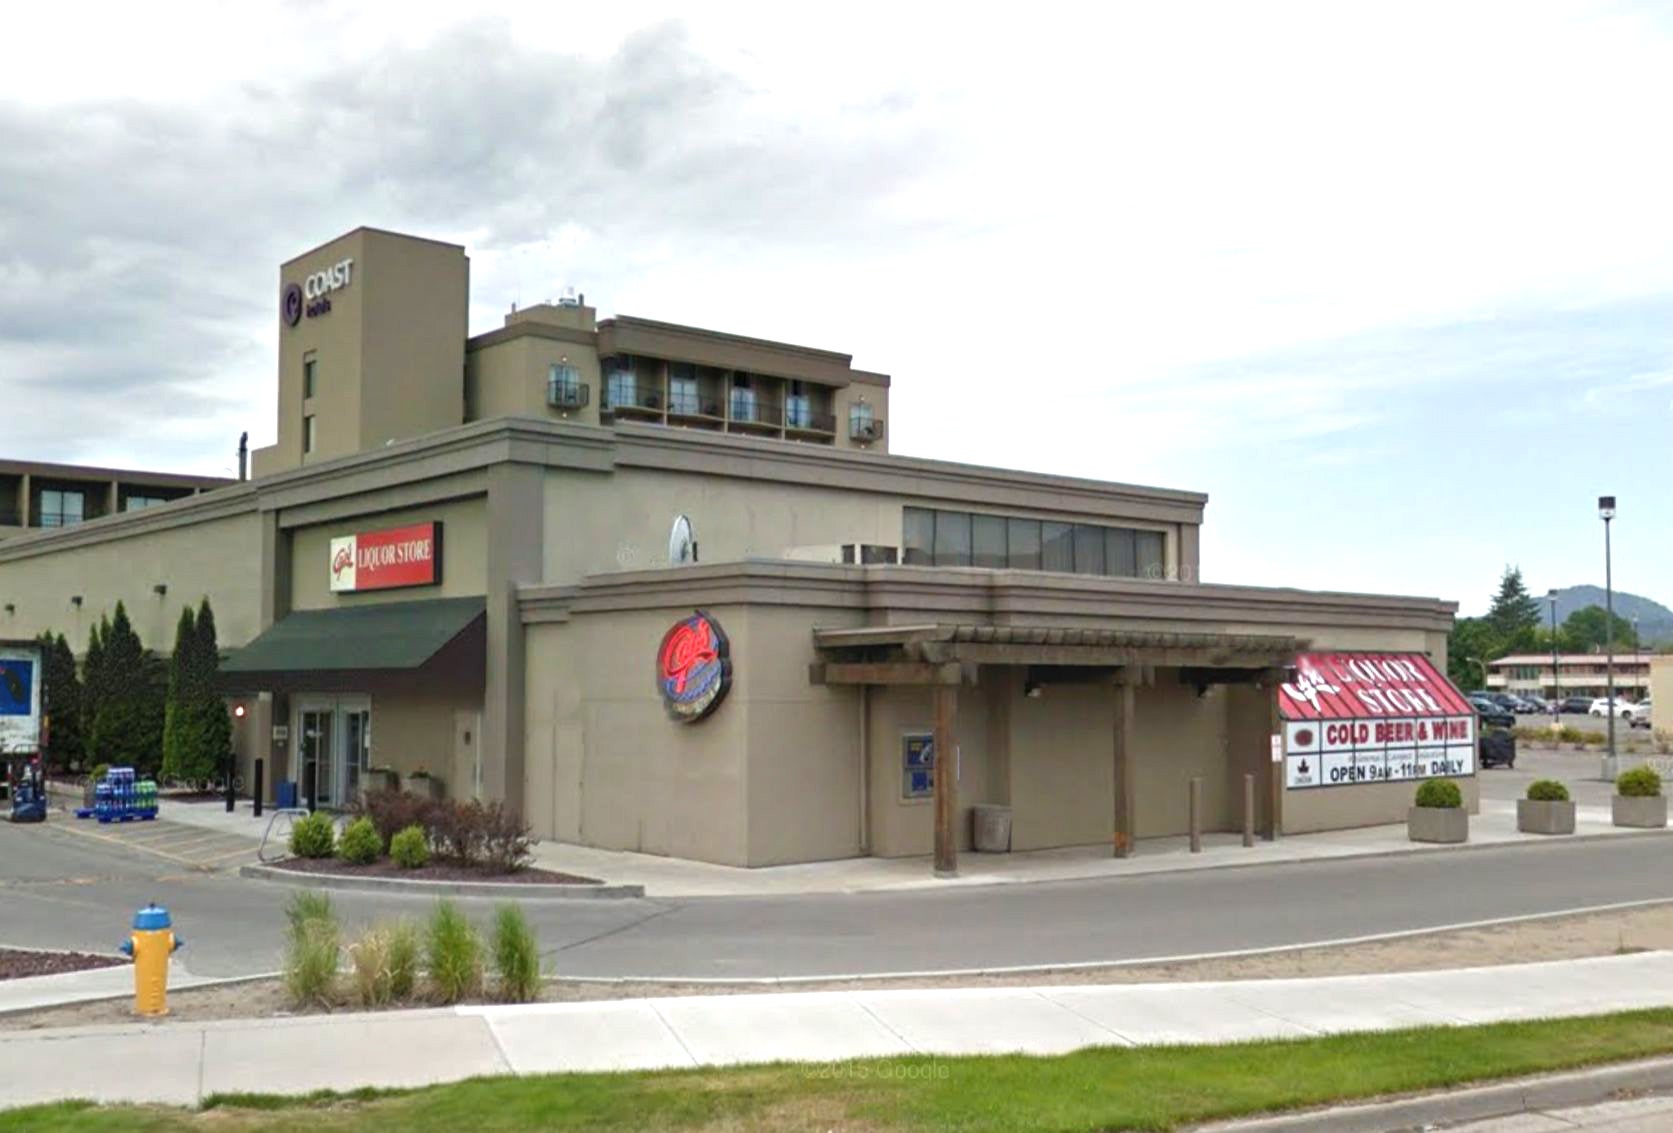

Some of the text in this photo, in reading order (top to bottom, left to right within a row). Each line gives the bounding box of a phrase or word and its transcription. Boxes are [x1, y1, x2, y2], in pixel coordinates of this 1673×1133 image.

[304, 258, 353, 299] COAST
[358, 544, 396, 572] LIQUOR
[397, 538, 432, 565] STORE
[1357, 688, 1441, 713] STORE
[1327, 720, 1468, 745] COLD BEER & WINE
[1330, 765, 1365, 782] OPEN
[1432, 759, 1463, 775] DAILY
